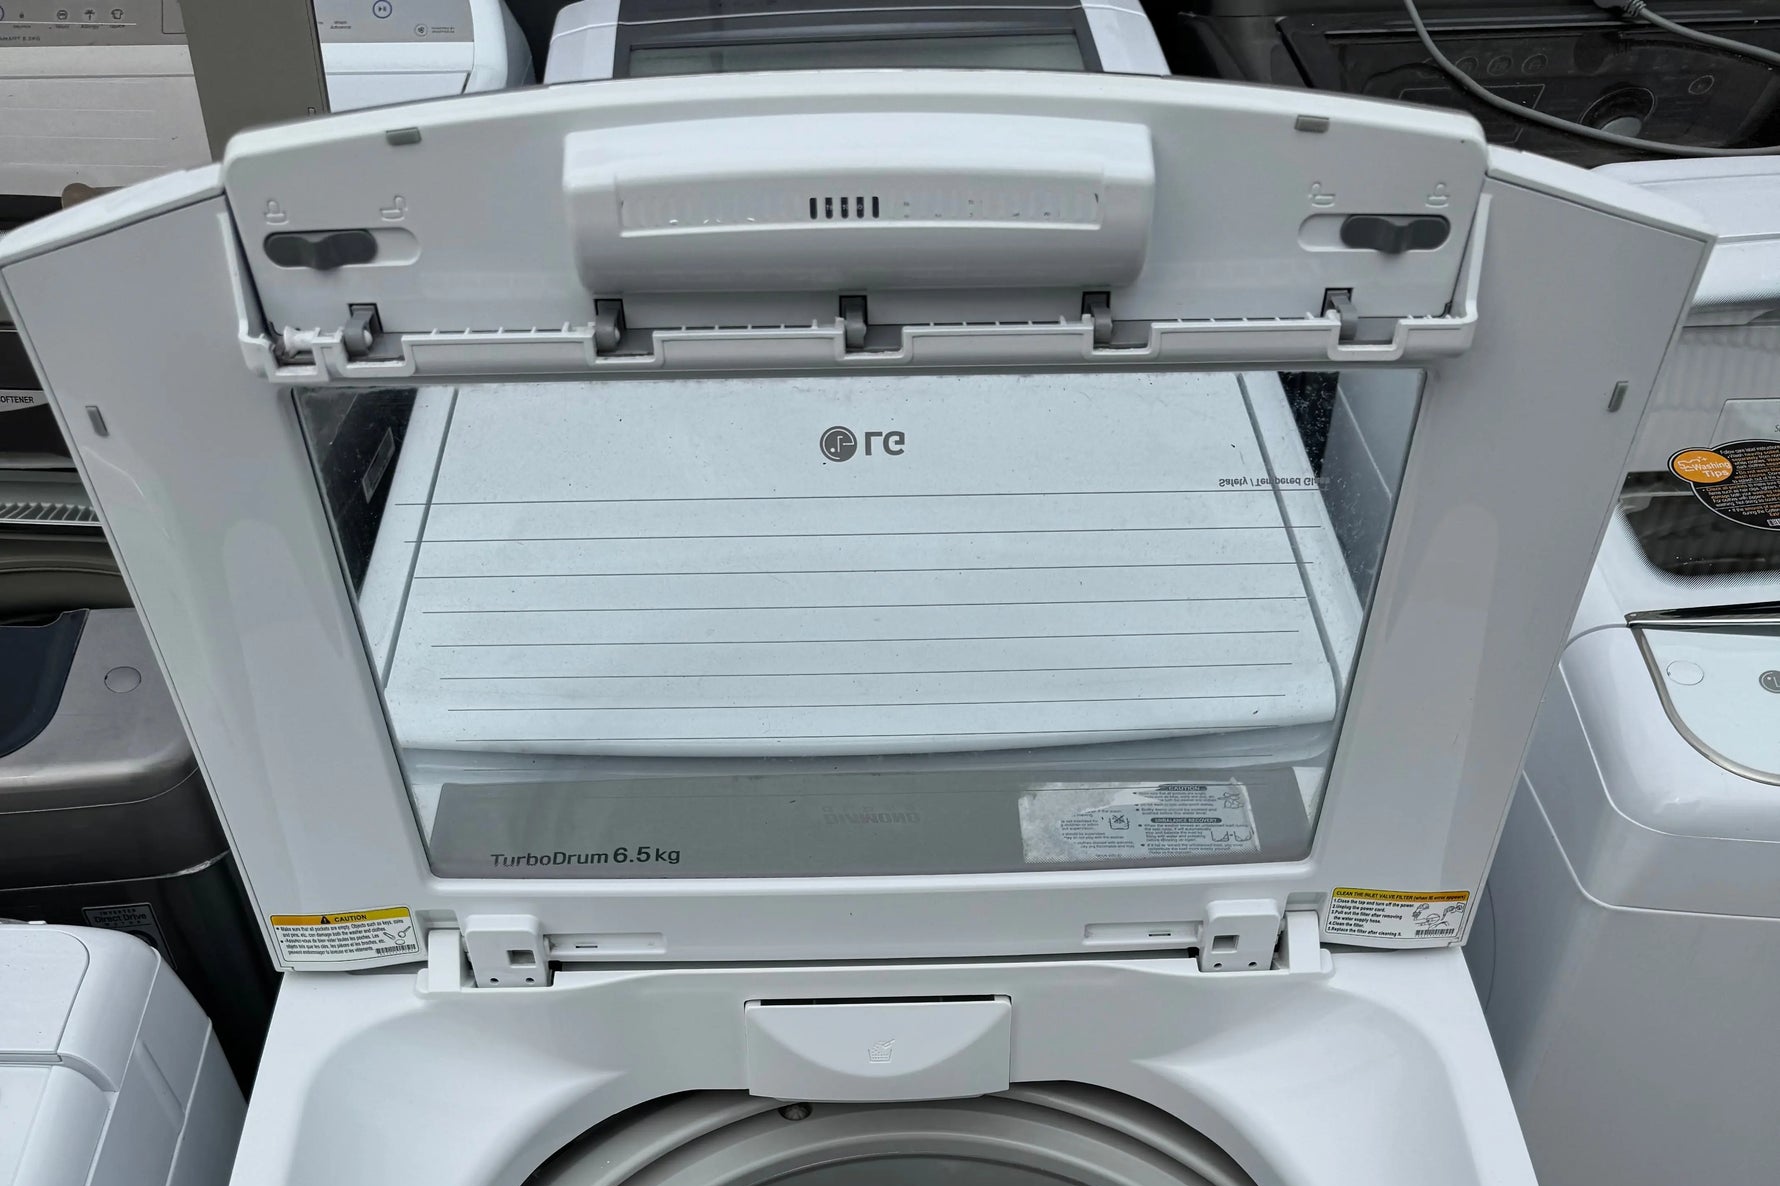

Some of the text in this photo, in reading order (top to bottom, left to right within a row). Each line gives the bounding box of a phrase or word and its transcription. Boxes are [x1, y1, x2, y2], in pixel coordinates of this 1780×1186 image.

[1694, 460, 1732, 471] Washing
[1703, 470, 1729, 478] Tips
[490, 852, 609, 868] TurboDrum
[334, 914, 368, 922] CAUTION
